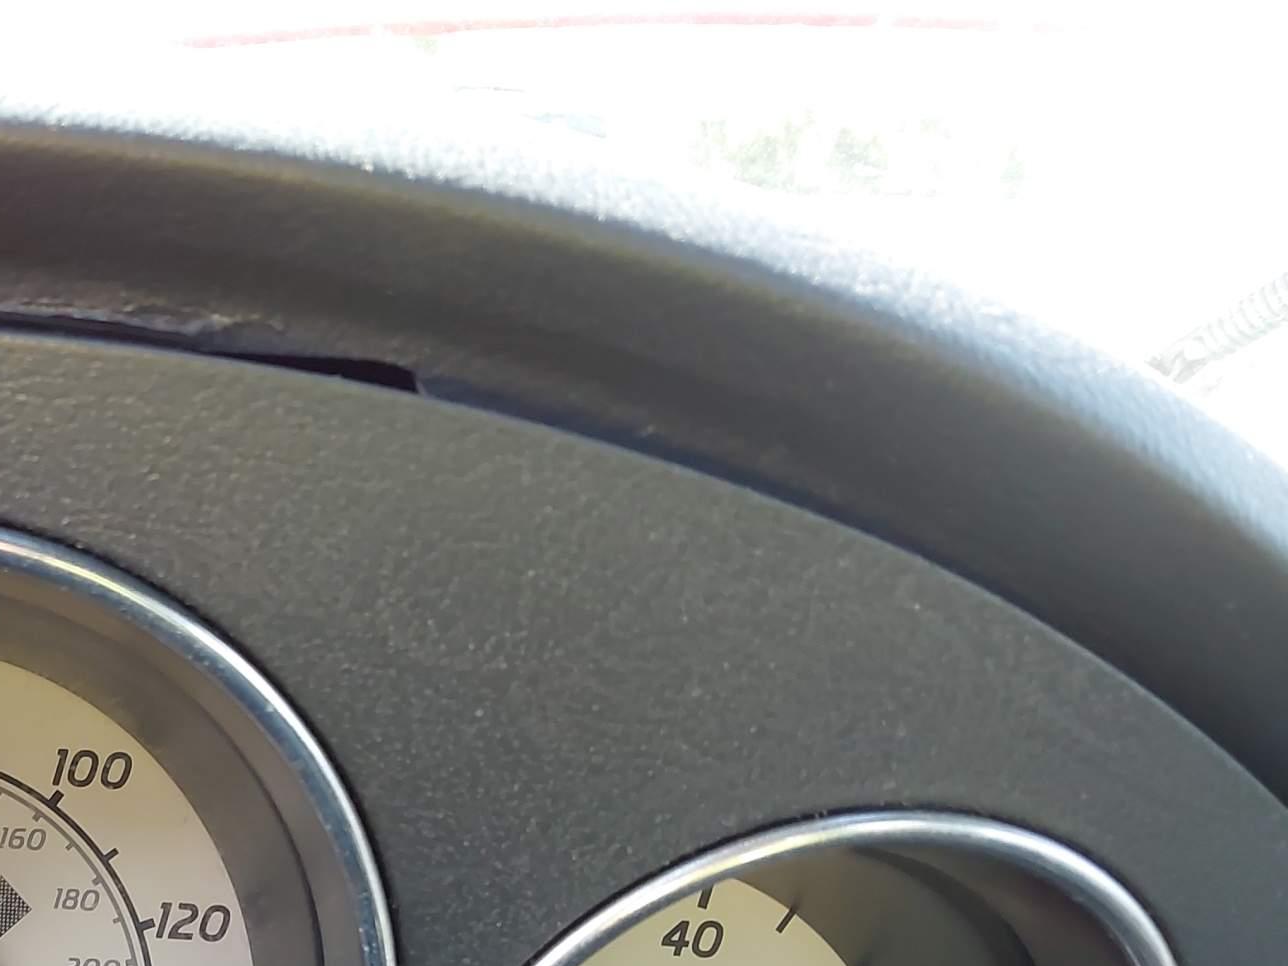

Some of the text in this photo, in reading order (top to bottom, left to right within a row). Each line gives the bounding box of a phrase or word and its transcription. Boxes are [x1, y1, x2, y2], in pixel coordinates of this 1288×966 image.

[53, 749, 132, 790] 100
[0, 827, 46, 850] 160
[53, 888, 99, 911] 180
[156, 902, 230, 942] 120
[661, 920, 724, 958] 40
